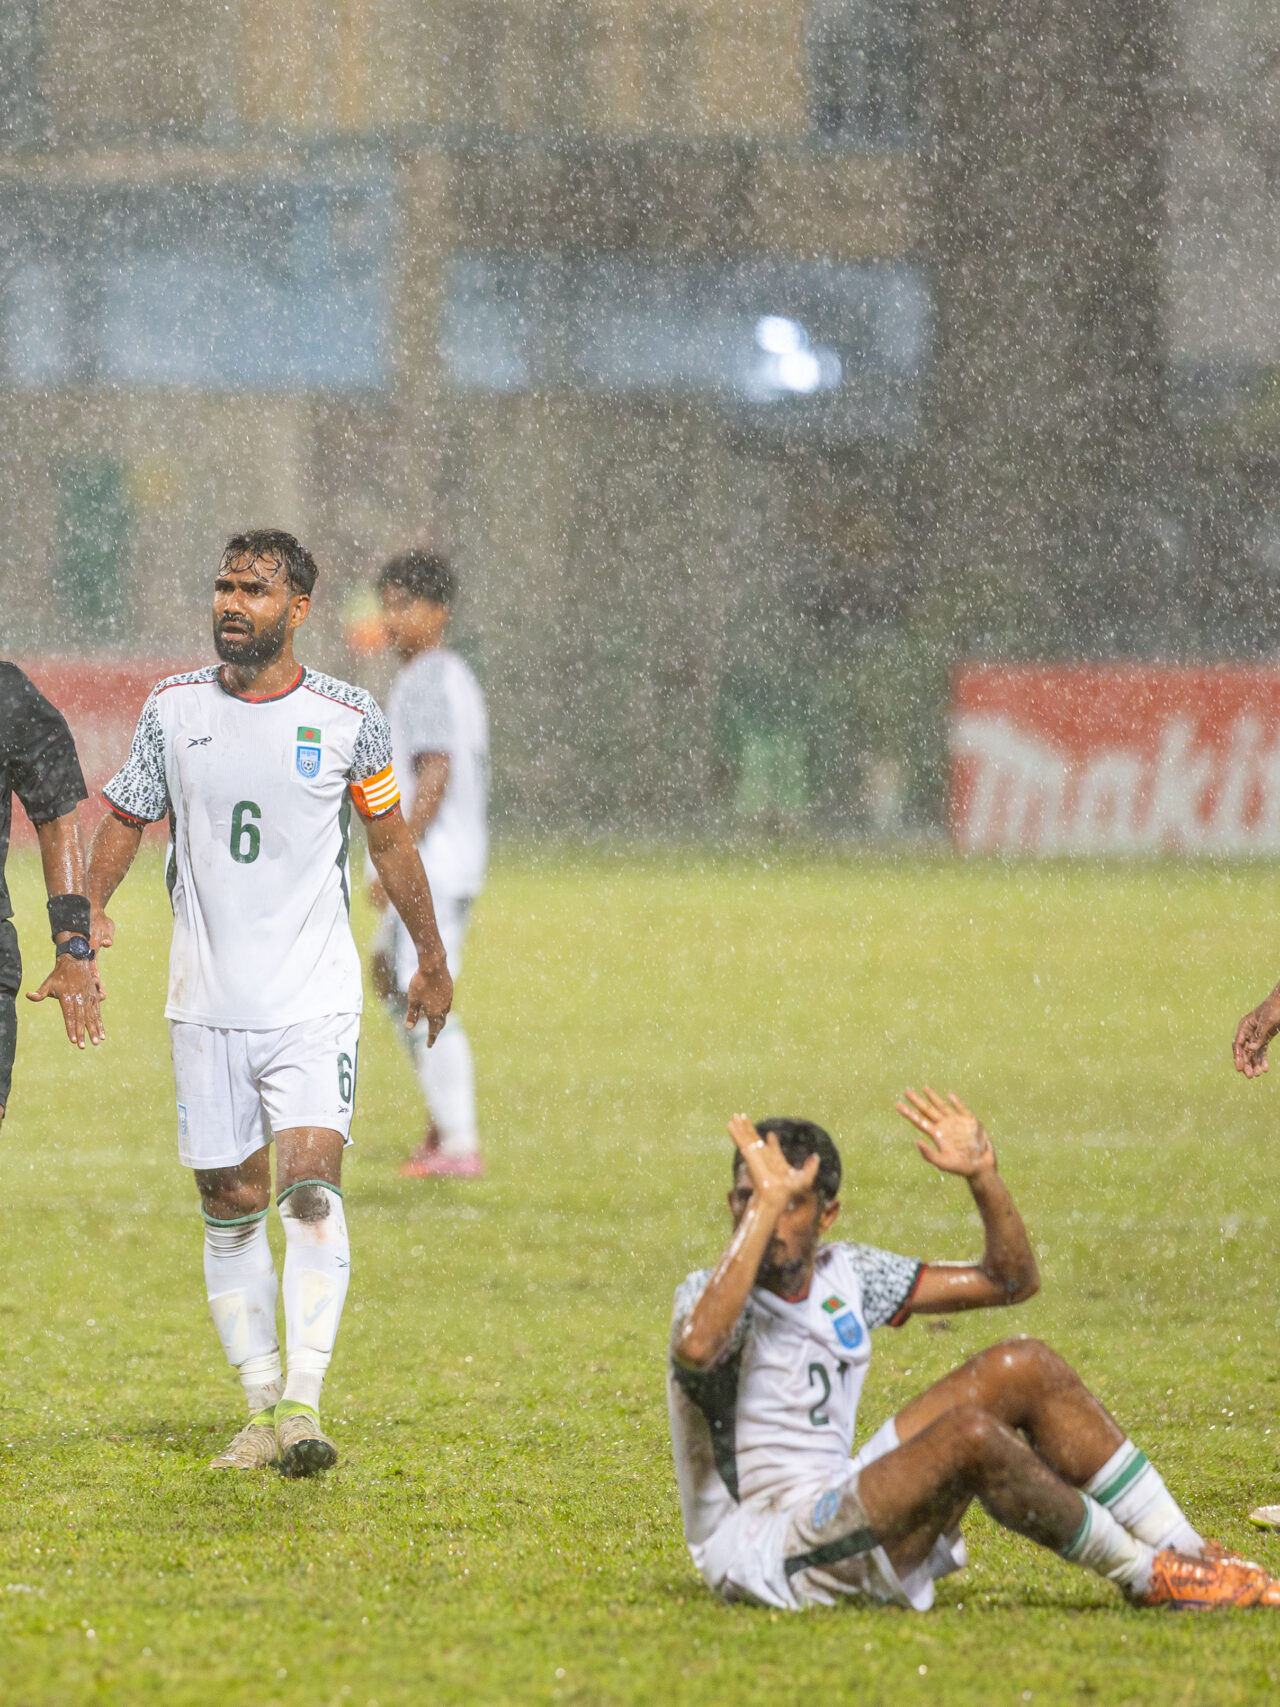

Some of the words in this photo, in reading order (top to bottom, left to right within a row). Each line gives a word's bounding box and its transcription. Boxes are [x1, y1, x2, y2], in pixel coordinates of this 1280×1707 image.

[229, 800, 262, 864] 6
[336, 1052, 353, 1104] 6
[807, 1361, 850, 1426] 2
